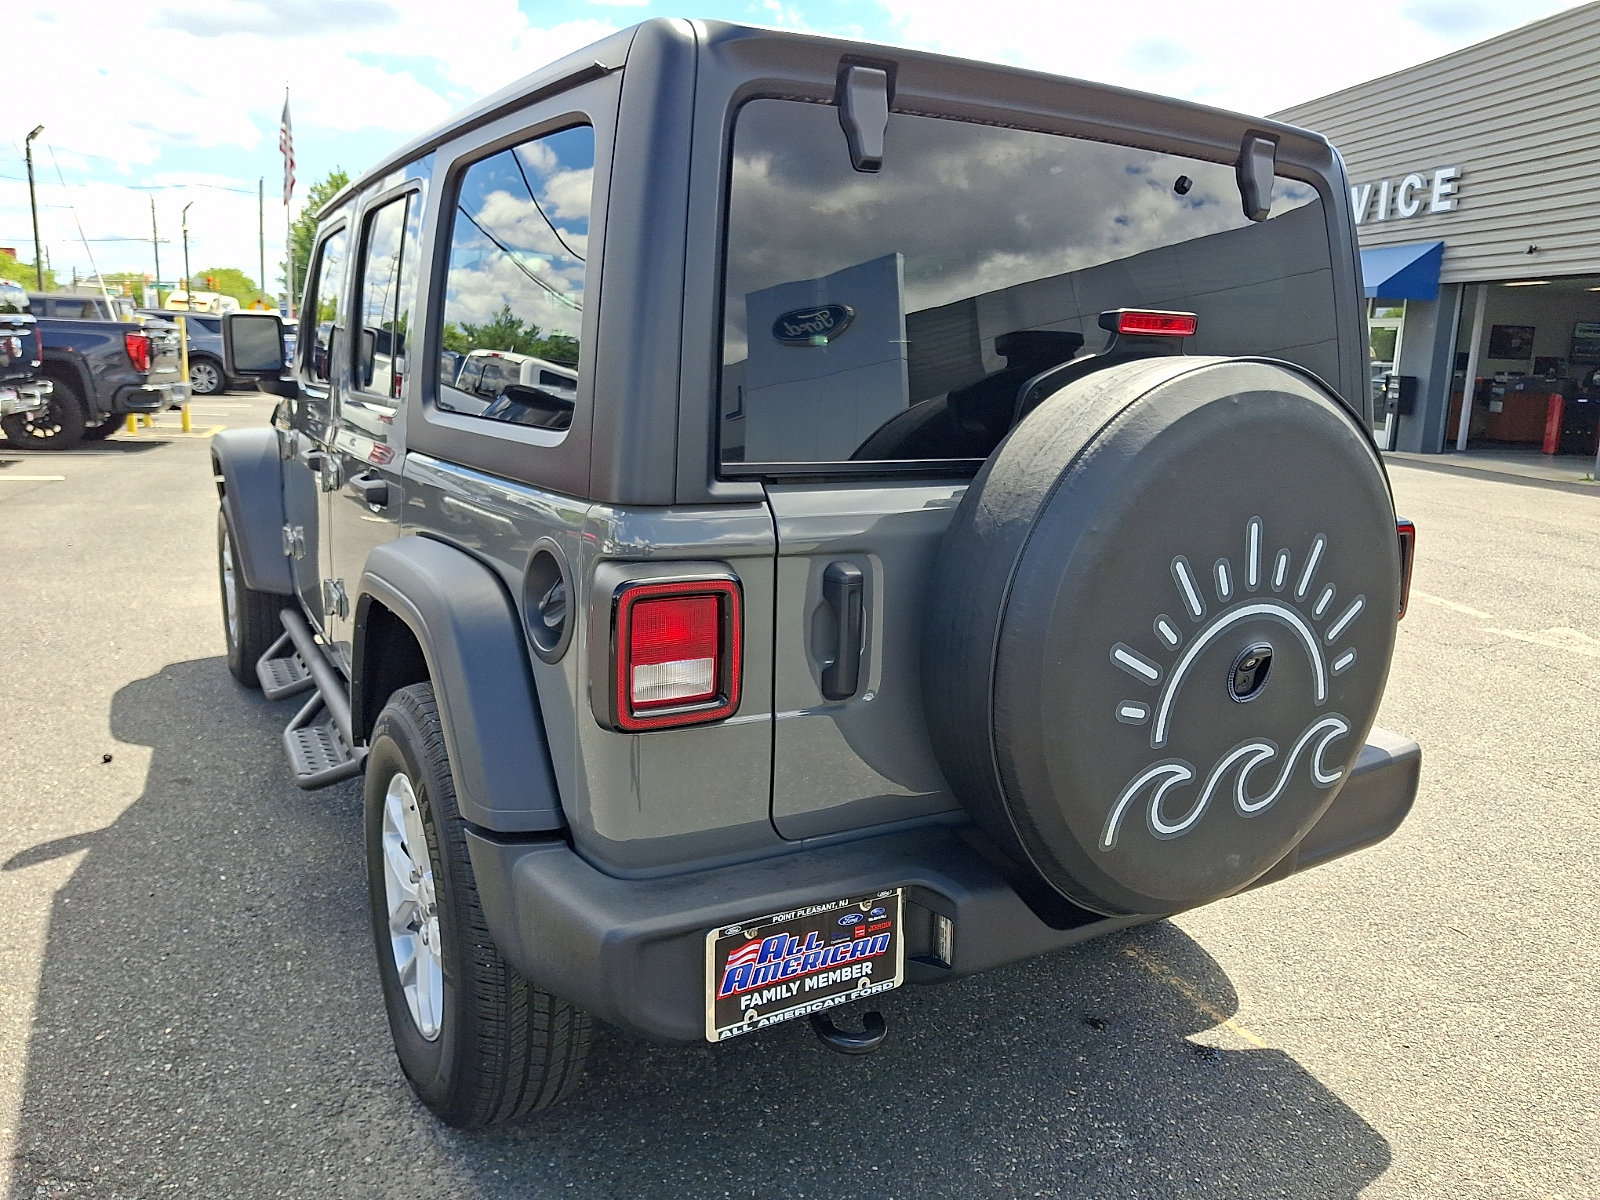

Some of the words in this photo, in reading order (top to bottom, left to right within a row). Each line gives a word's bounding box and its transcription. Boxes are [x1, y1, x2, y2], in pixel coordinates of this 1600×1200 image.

[1351, 167, 1461, 225] VICE
[772, 911, 796, 923] POINT
[797, 901, 838, 917] PLEASANT,
[839, 899, 849, 907] NJ
[719, 1024, 754, 1039] ALL
[757, 995, 847, 1028] AMERICAN
[850, 981, 895, 1000] FORD
[740, 980, 801, 1011] FAMILY
[804, 961, 873, 992] MEMBER
